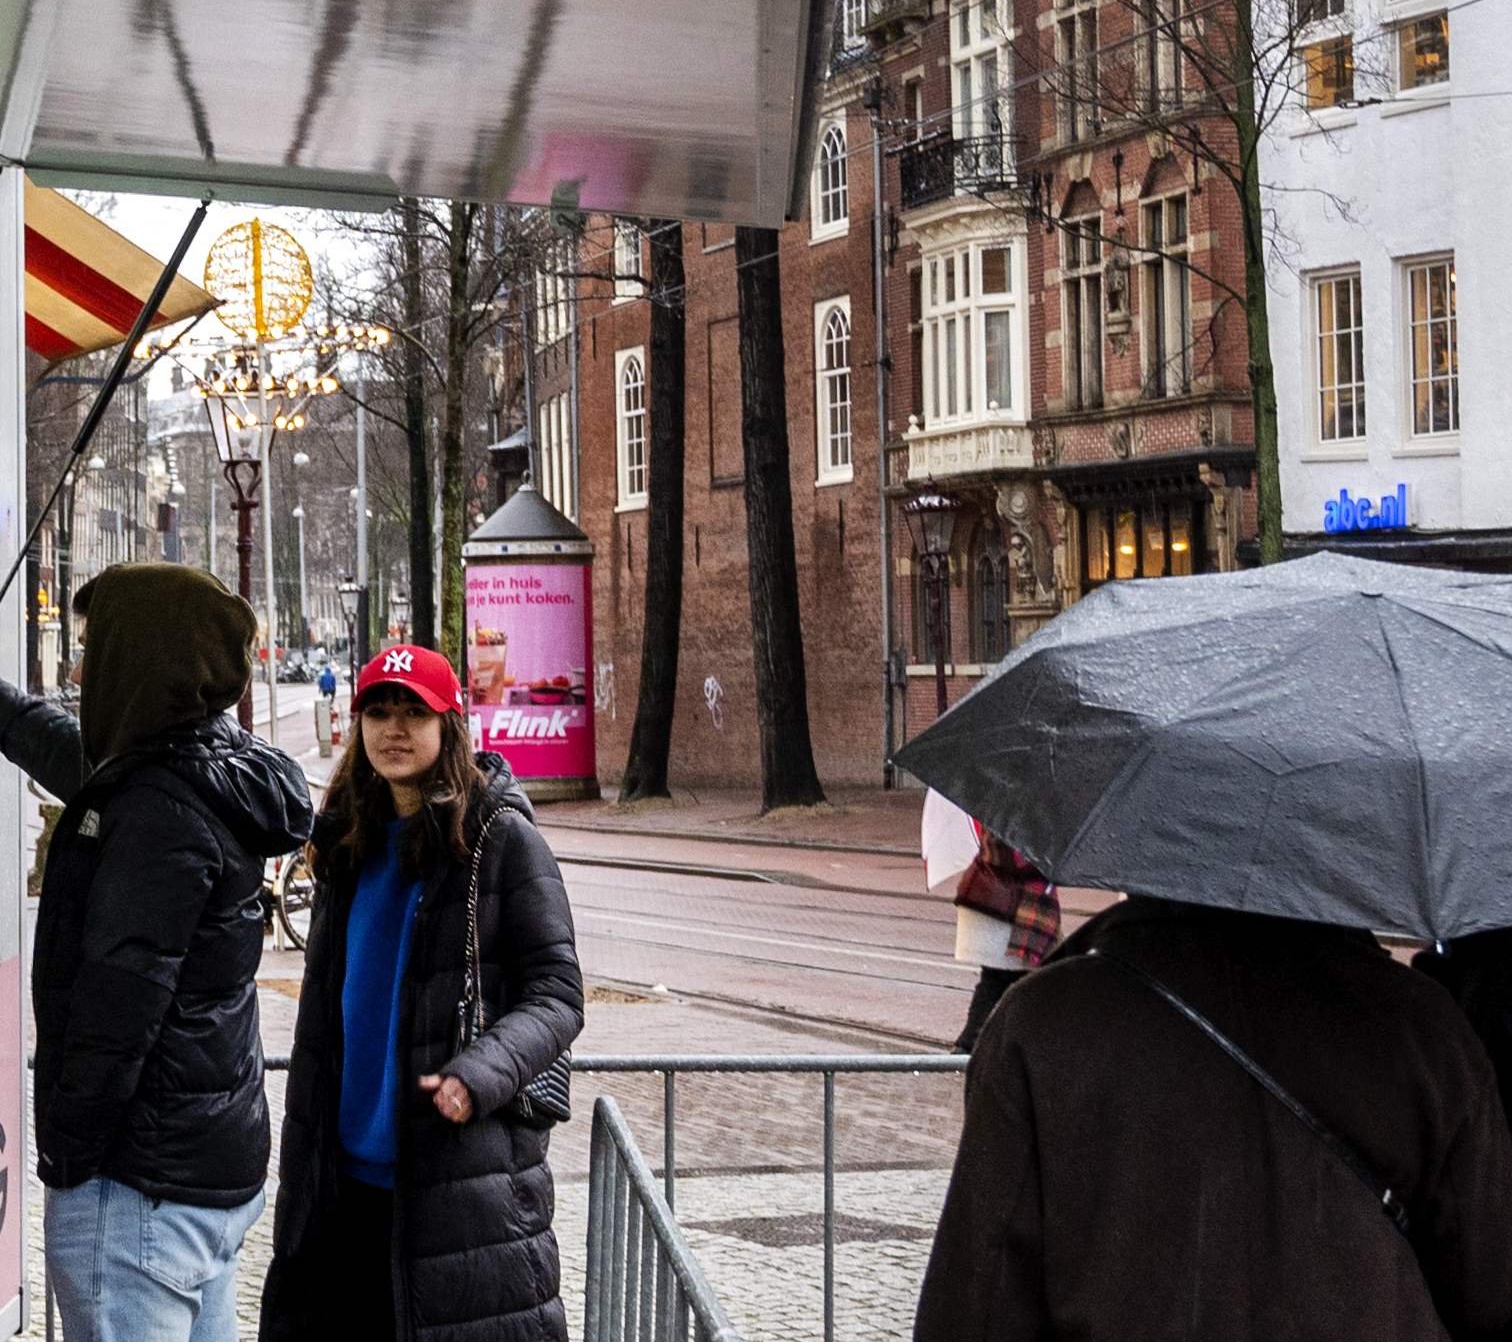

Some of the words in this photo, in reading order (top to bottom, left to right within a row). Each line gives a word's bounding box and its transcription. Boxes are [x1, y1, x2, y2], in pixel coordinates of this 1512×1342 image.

[1323, 483, 1406, 532] abc.nl
[493, 576, 505, 589] in
[510, 576, 542, 589] huis
[489, 593, 520, 605] kunt
[526, 592, 574, 605] koken.
[382, 649, 414, 673] NY
